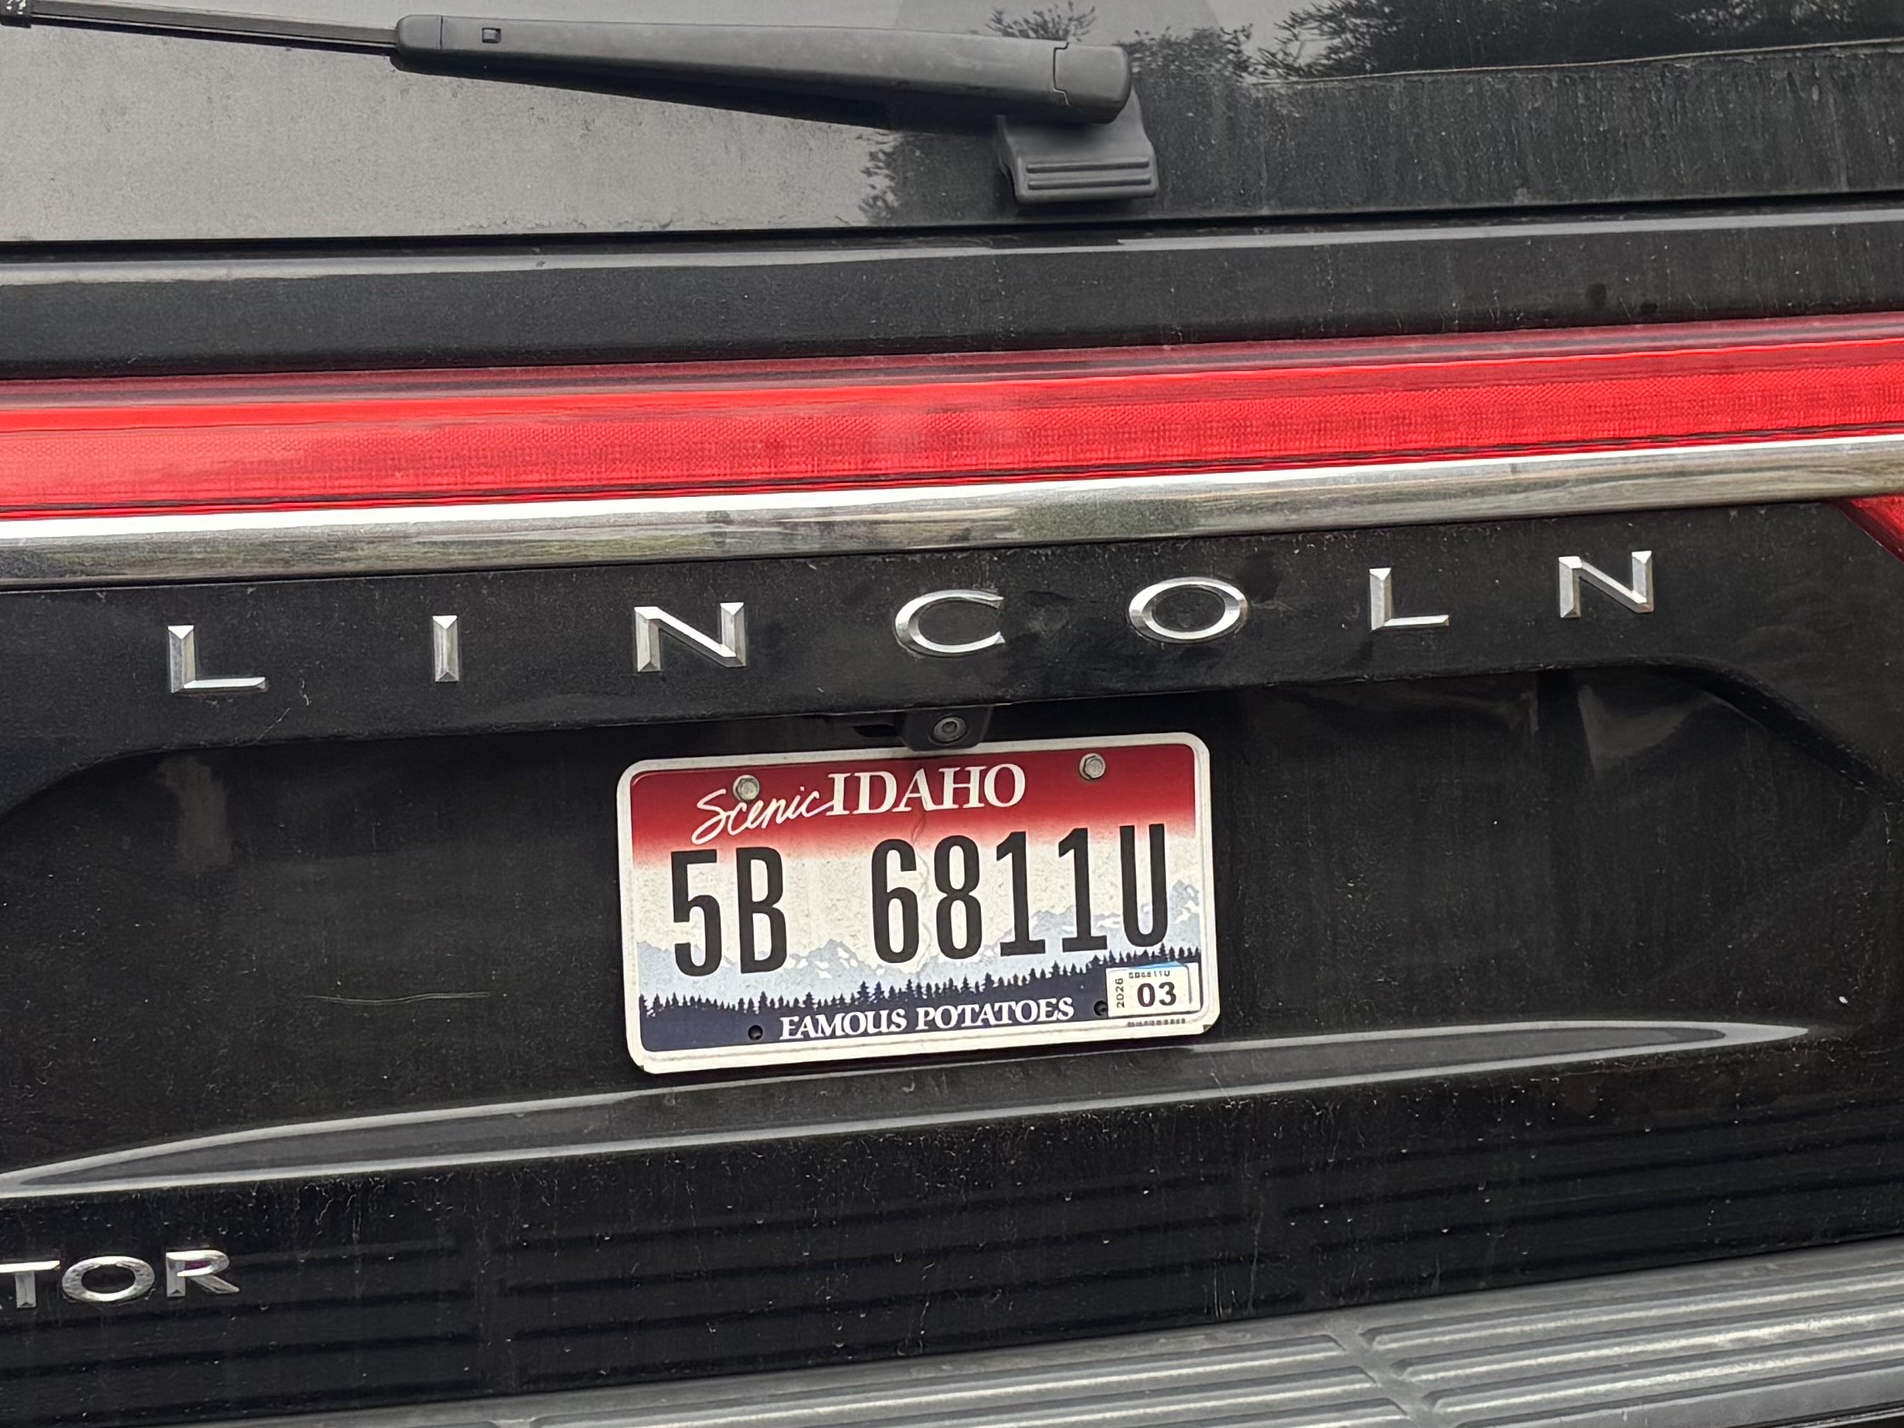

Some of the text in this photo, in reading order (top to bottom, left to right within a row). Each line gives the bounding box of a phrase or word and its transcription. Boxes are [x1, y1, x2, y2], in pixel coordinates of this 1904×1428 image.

[168, 549, 1655, 693] LINCOLN
[691, 763, 1027, 845] Scenic IDAHO
[670, 823, 1170, 977] 5B 6811U
[779, 997, 1075, 1041] FAMOUS POTATOES
[1114, 977, 1125, 1009] 2026
[1137, 981, 1177, 1008] 03
